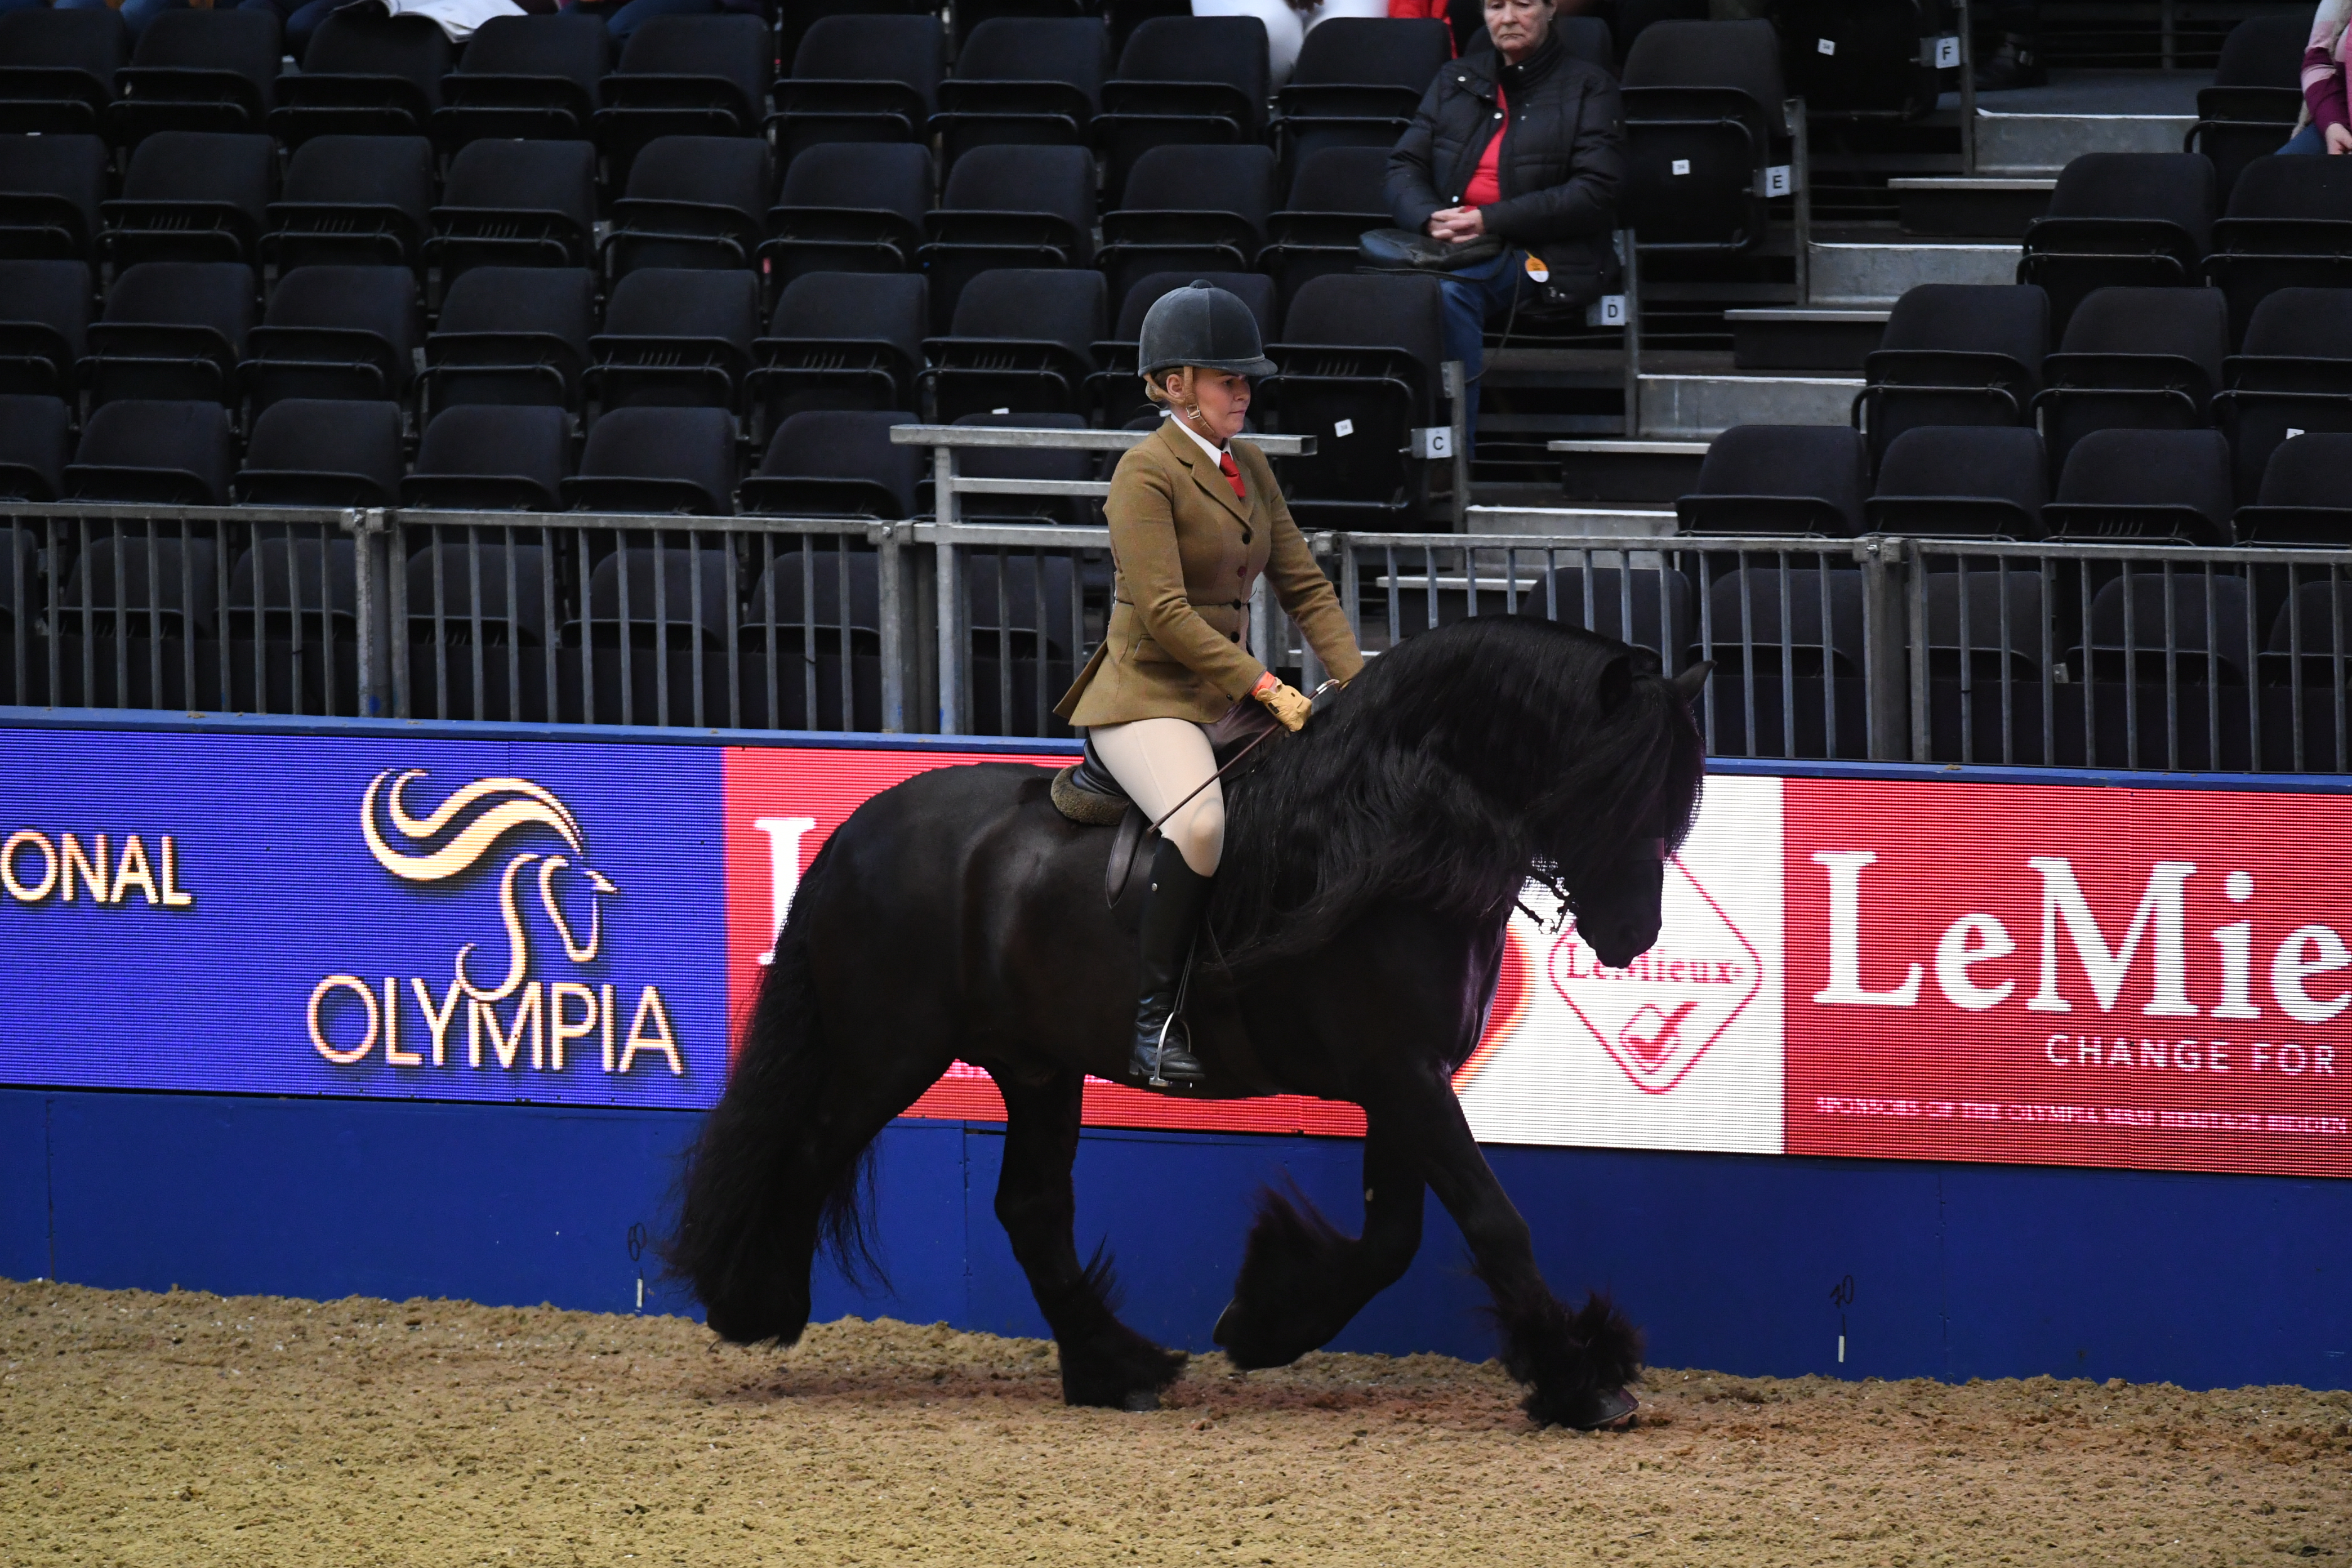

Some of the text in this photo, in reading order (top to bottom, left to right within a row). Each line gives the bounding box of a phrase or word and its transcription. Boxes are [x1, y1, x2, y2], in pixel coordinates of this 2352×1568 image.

[1942, 46, 1952, 60] F
[1772, 175, 1783, 189] E
[1608, 304, 1618, 318] D
[1433, 436, 1444, 451] C
[1, 830, 191, 905] ONAL
[1811, 850, 2352, 1023] LeMie
[308, 975, 684, 1076] OLYMPIA
[2046, 1034, 2335, 1075] CHANGE FOR
